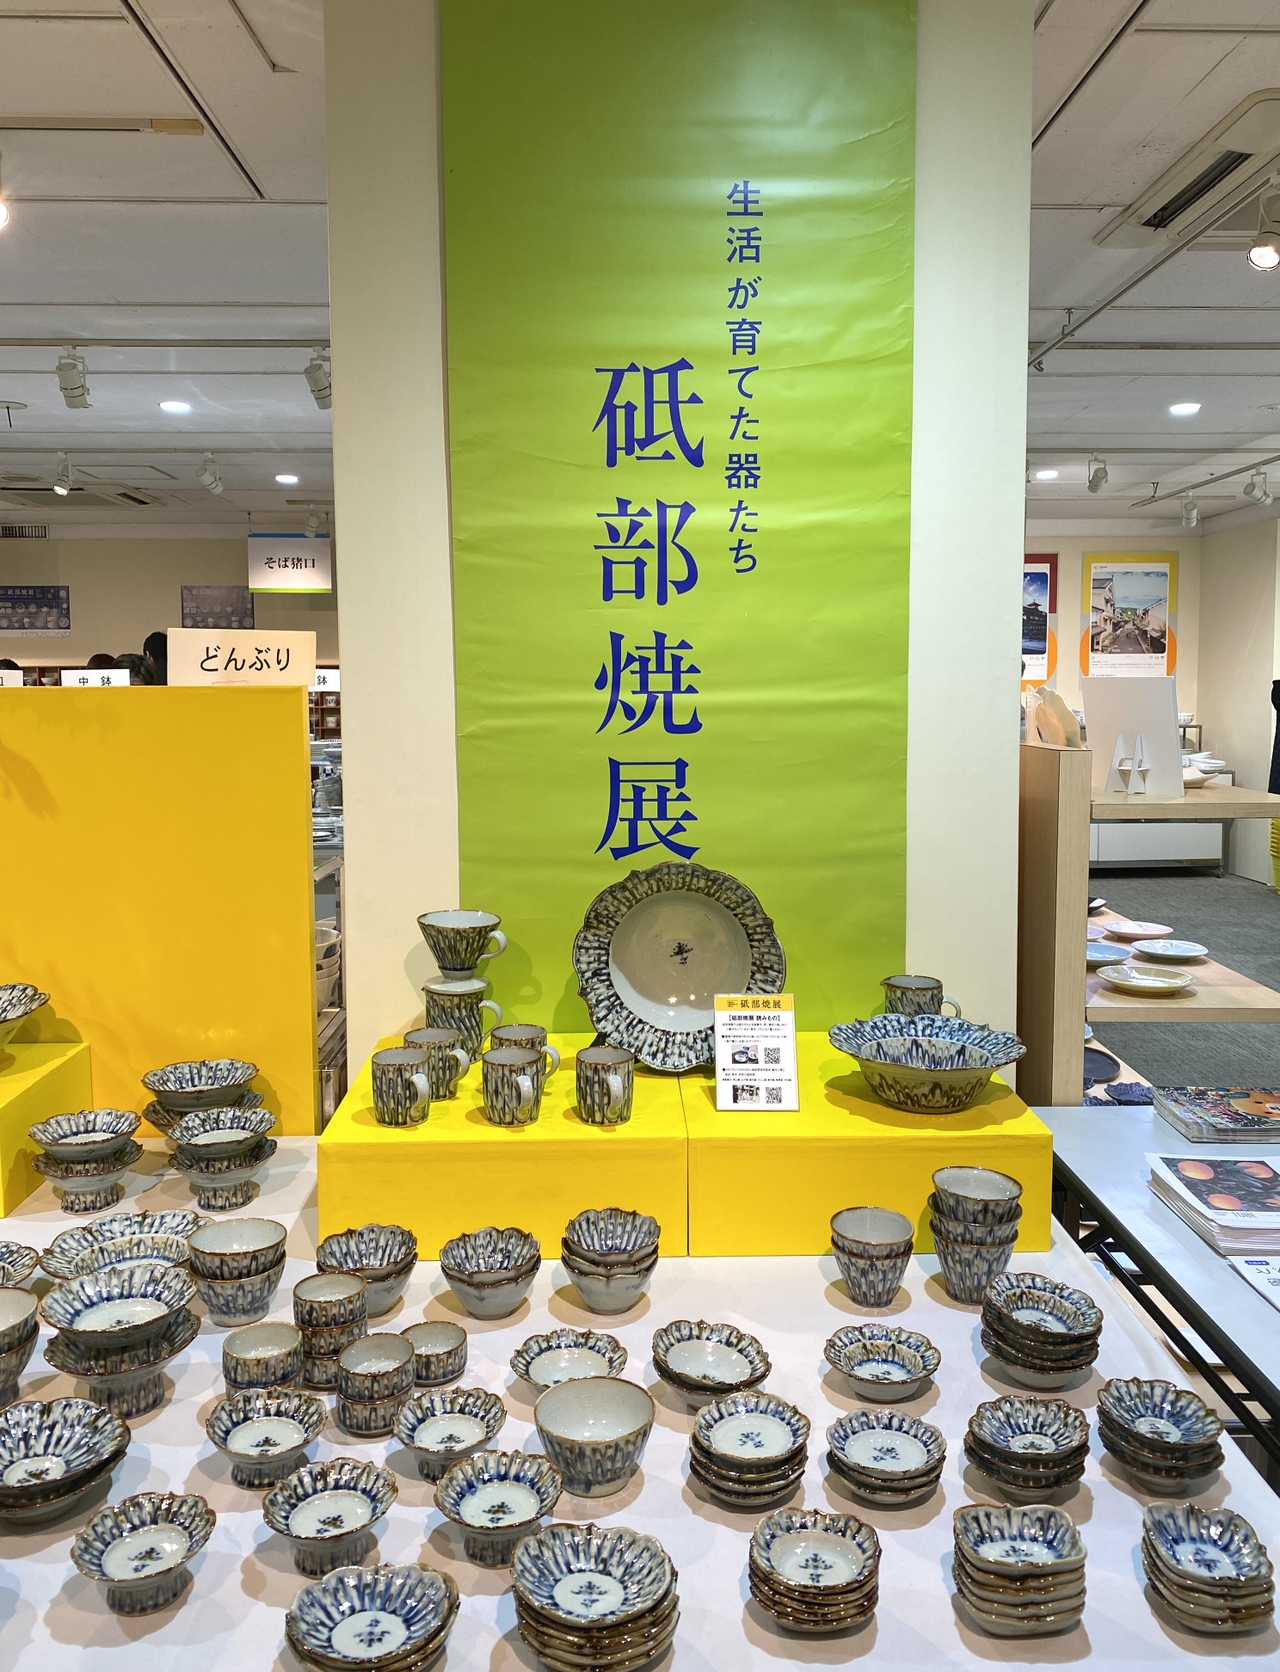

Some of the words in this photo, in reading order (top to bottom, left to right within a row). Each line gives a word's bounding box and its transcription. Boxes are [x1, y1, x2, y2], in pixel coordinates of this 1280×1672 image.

[726, 180, 763, 574] 生活が育てた器たち
[264, 556, 316, 570] そば猪口
[592, 357, 706, 862] 砥部焼展
[199, 645, 291, 672] どんぶり
[740, 999, 782, 1009] 砥部焼展
